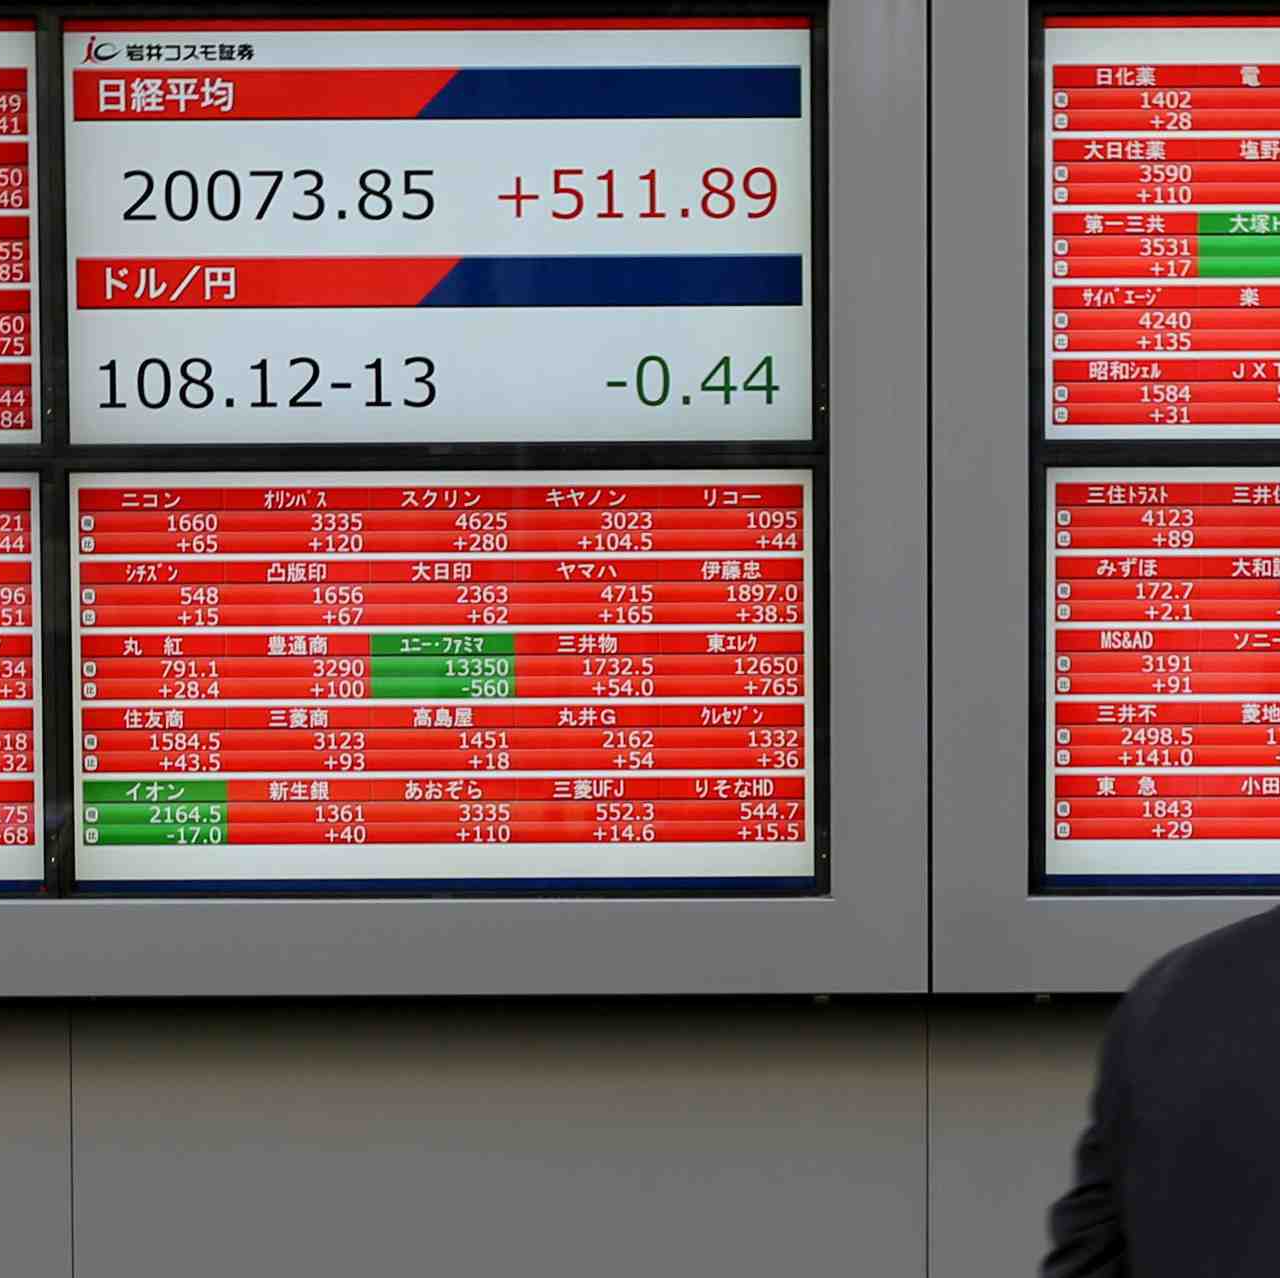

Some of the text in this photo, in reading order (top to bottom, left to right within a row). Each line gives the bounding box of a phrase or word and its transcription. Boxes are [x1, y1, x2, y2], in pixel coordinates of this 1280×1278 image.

[126, 44, 254, 62] 岩井コスモ証券
[1097, 67, 1155, 86] 日化薬
[99, 77, 234, 113] 日経平均
[1141, 91, 1191, 108] 1402
[1151, 112, 1191, 130] +28
[122, 166, 778, 222] 20073.85 +511.89
[99, 355, 780, 410] 108.12-13 -0.44
[122, 493, 180, 508] ニコン
[546, 489, 625, 507] キヤノン
[168, 514, 217, 532] 1660
[602, 512, 652, 529] 3023
[177, 531, 217, 553] +65
[578, 533, 652, 551] +104.5
[702, 560, 761, 580] 伊藤忠
[1097, 558, 1157, 577] みずほ
[728, 585, 797, 602] 1897.0
[1136, 582, 1193, 599] 172.7
[736, 605, 797, 624] +38.5
[1145, 603, 1192, 621] +2.1
[558, 634, 617, 653] 三井物
[584, 658, 653, 675] 1732.5
[593, 679, 653, 697] +54.0
[1098, 704, 1156, 723] 三井不
[1122, 728, 1192, 745] 2498.5
[1119, 748, 1192, 767] +141.0
[127, 782, 184, 801] イオン
[150, 806, 221, 823] 2164.5
[167, 826, 221, 844] -17.0
